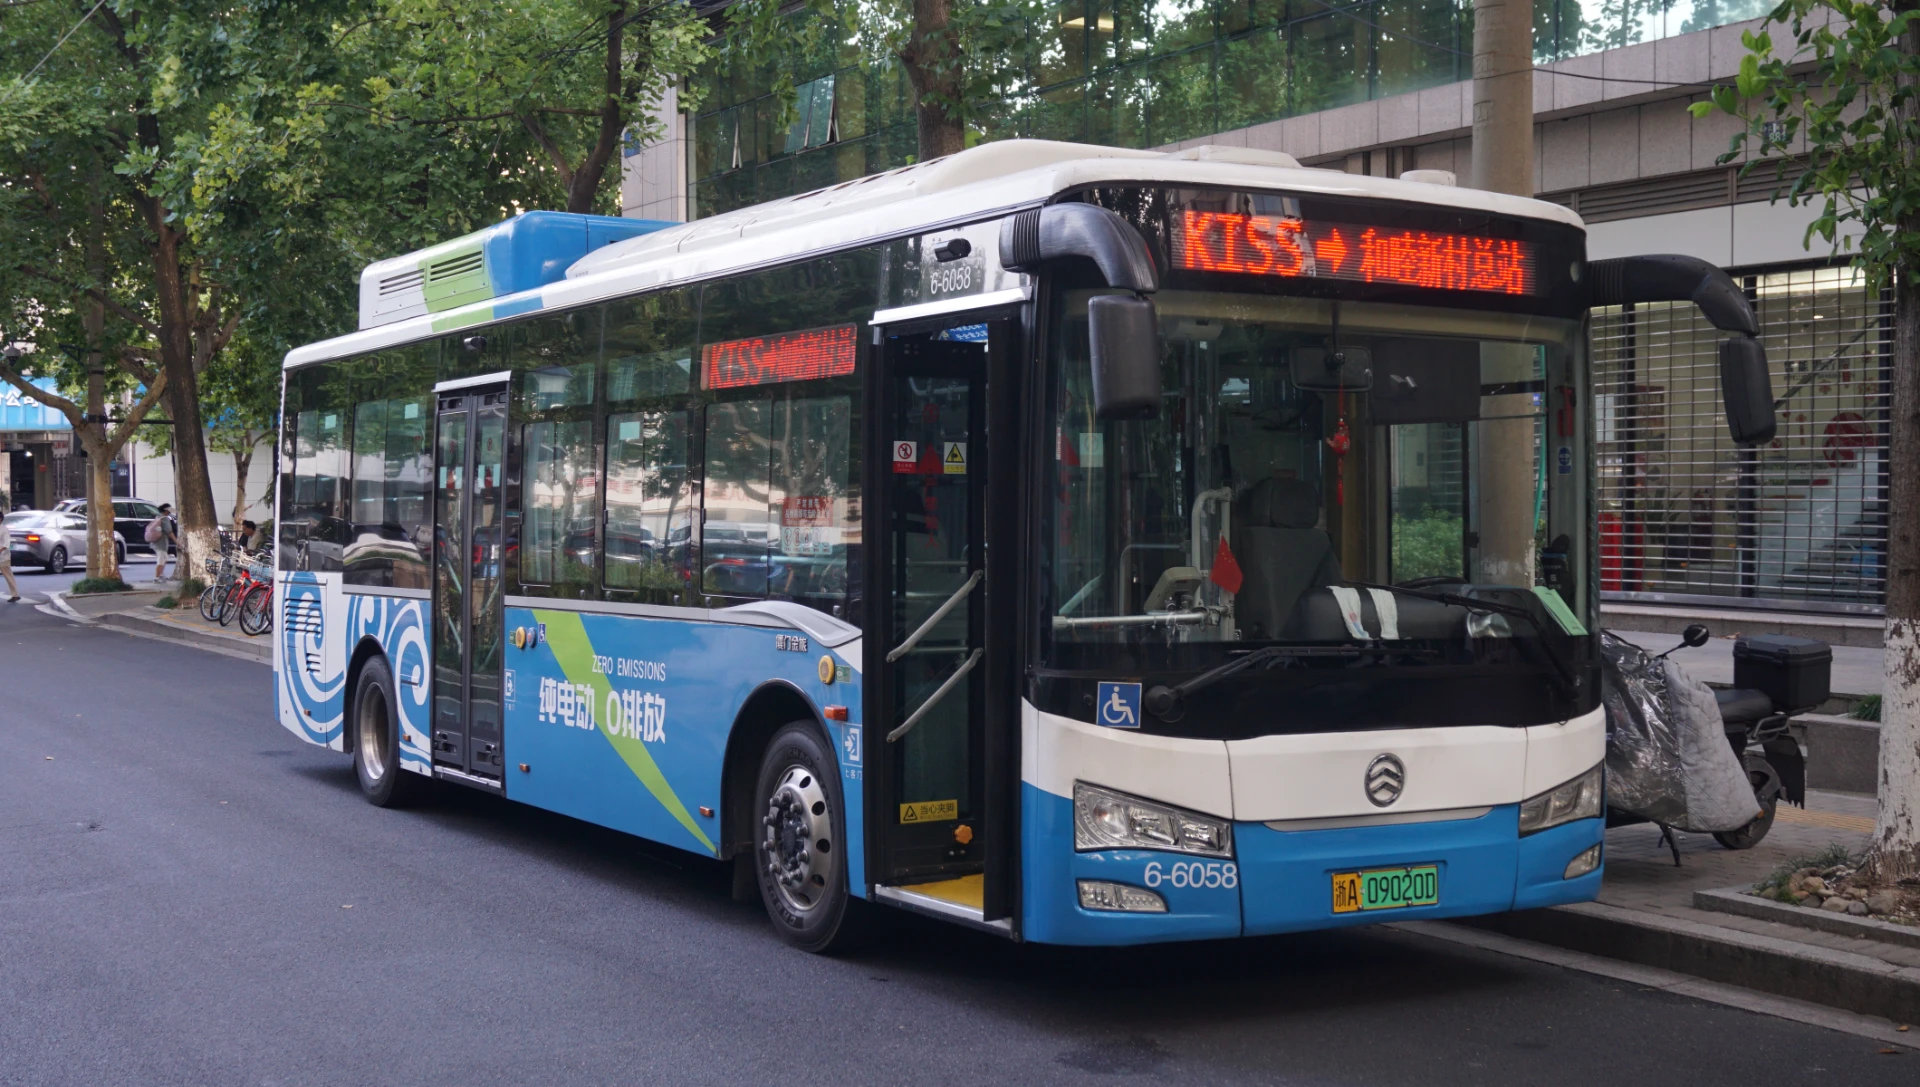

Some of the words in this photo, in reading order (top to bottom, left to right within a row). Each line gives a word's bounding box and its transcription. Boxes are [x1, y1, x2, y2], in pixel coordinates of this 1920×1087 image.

[1359, 228, 1524, 294] 和睦新村总站
[930, 266, 971, 294] 6-6058
[777, 327, 856, 382] 和睦新村总
[592, 655, 613, 674] ZERO
[617, 657, 666, 681] EMISSIONS
[539, 677, 595, 731] 纯电动
[1144, 861, 1238, 889] 6-6058
[1335, 879, 1358, 907] 浙A
[1367, 872, 1436, 904] 09020D
